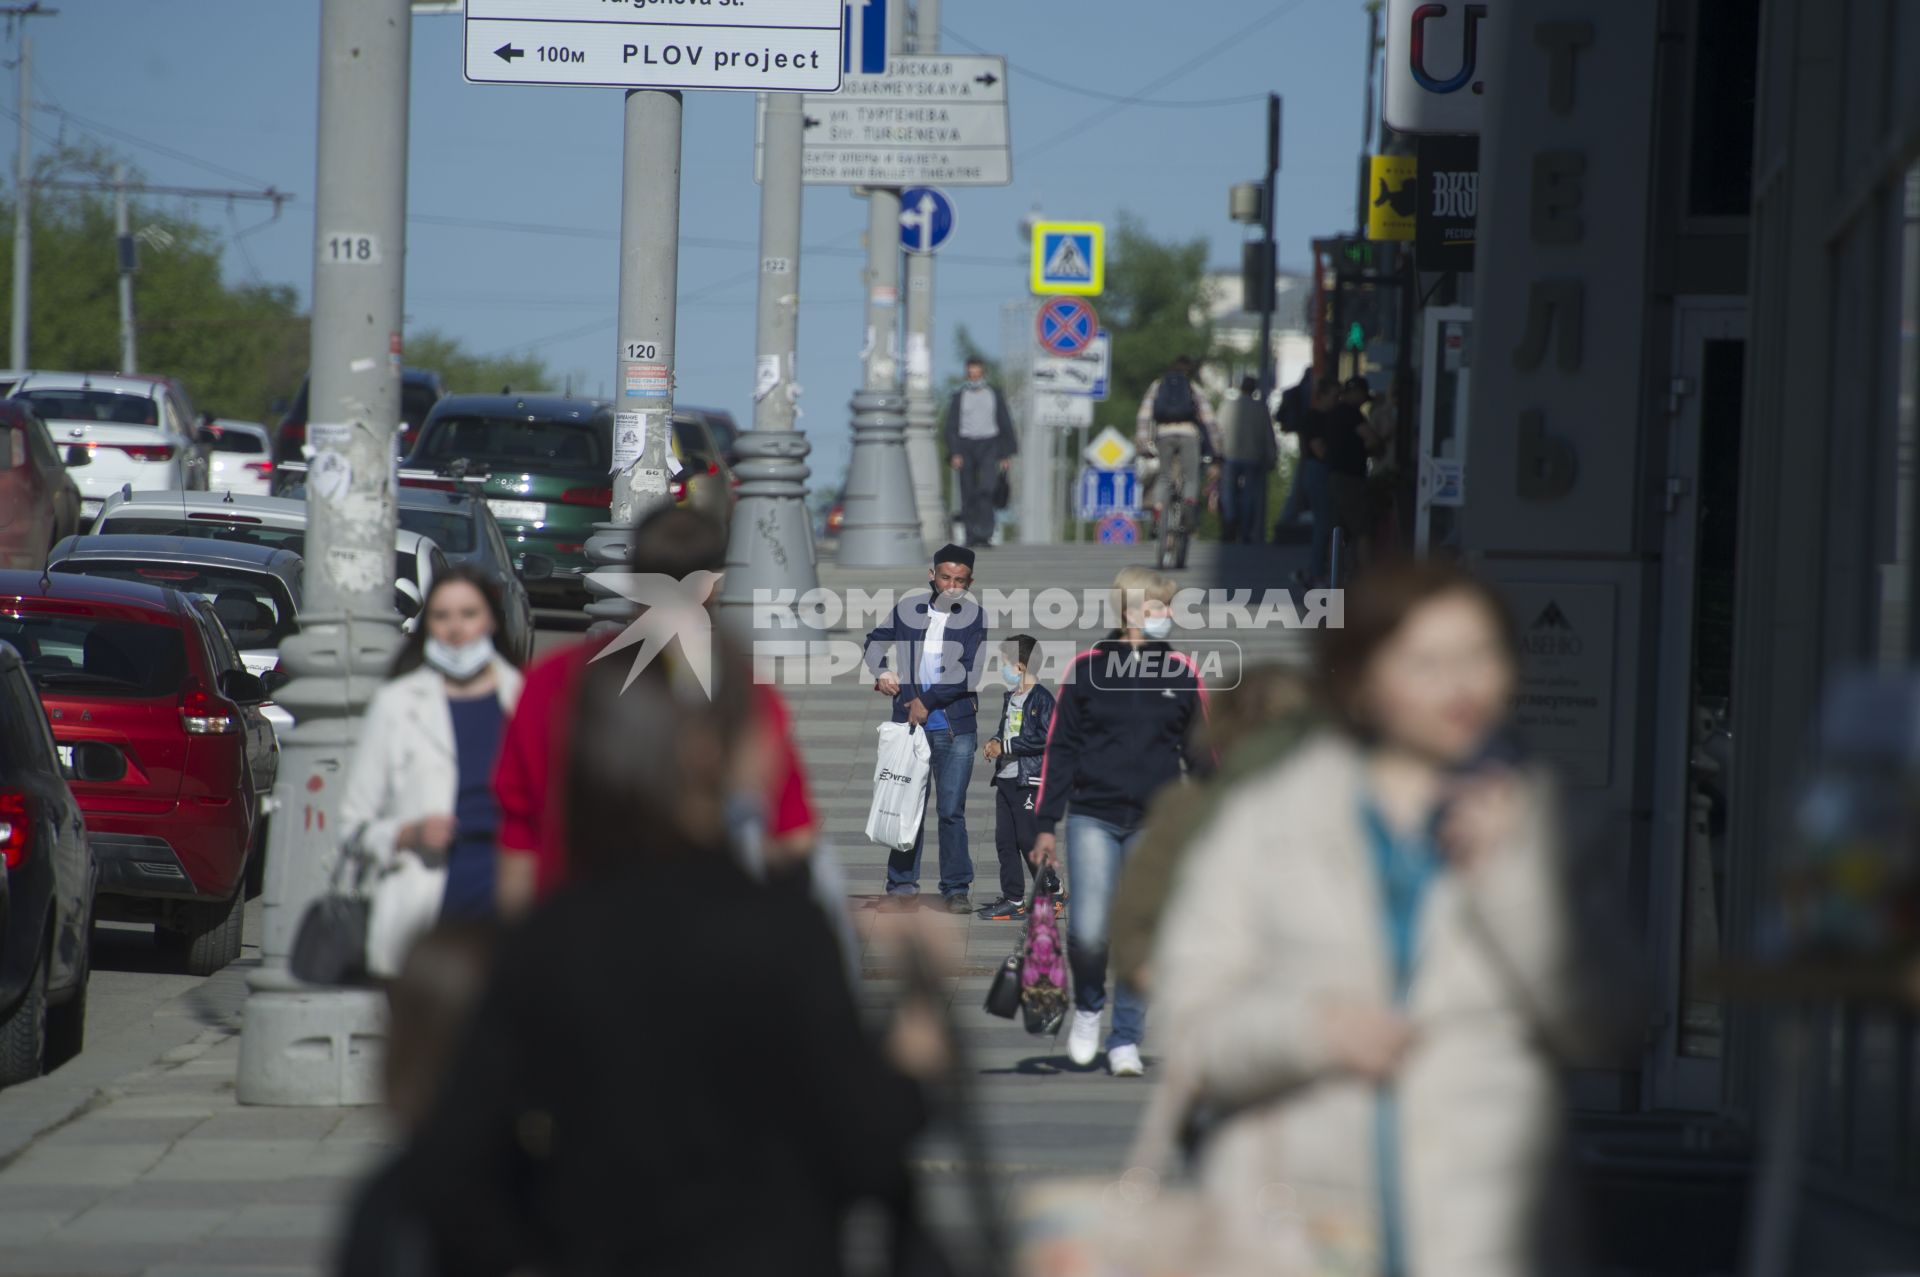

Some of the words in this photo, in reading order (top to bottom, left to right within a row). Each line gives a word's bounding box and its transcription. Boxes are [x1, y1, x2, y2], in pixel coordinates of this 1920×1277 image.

[623, 44, 703, 65] PLOV
[714, 48, 819, 72] project
[328, 238, 371, 260] 118
[628, 345, 656, 359] 120
